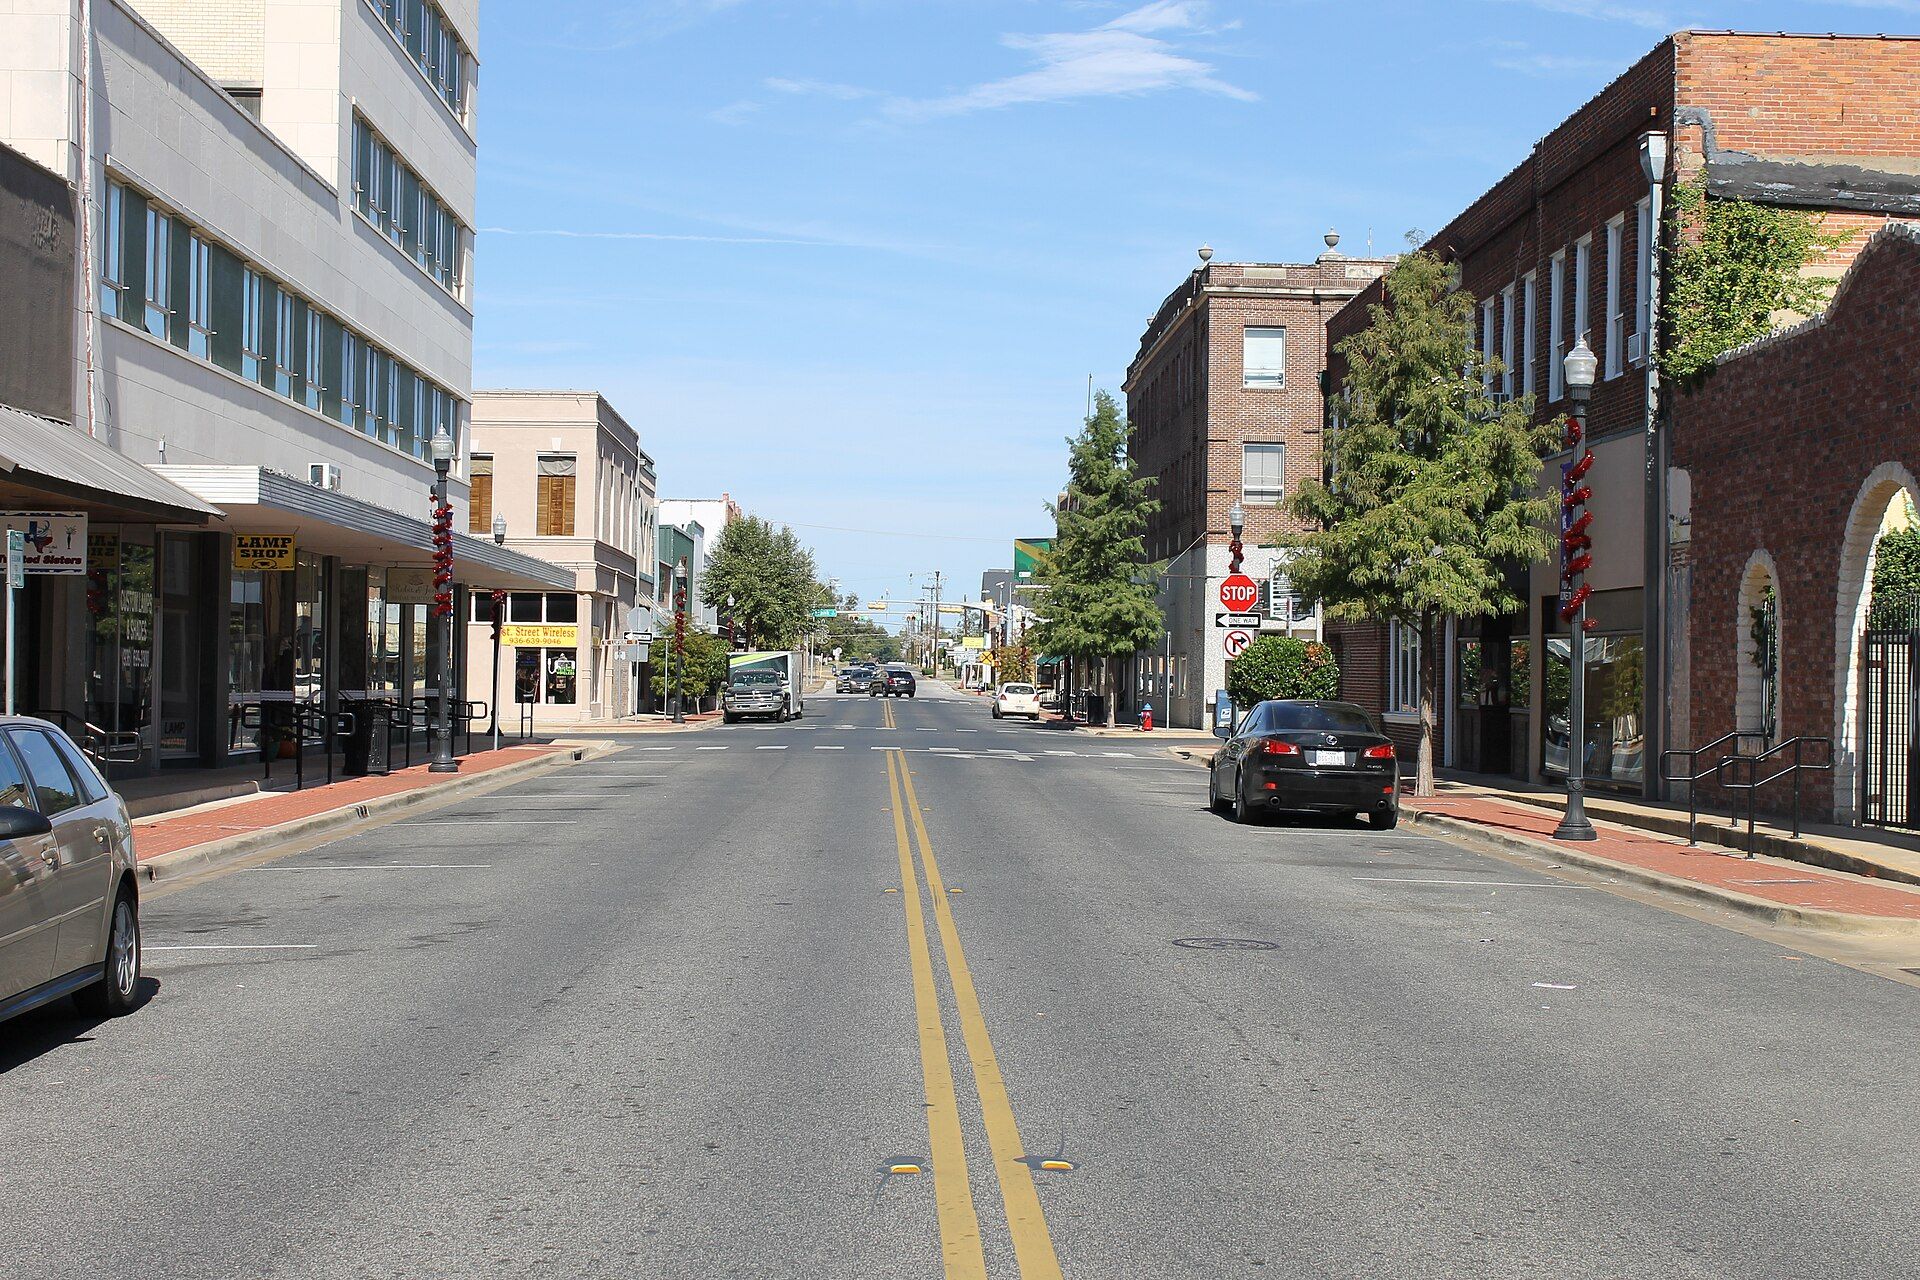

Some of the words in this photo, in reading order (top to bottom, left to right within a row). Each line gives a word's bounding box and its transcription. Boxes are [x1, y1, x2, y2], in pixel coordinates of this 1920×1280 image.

[237, 537, 292, 548] LAMP
[240, 549, 288, 558] SHOP
[43, 555, 82, 564] Sisters
[1222, 586, 1255, 601] STOP
[515, 627, 540, 637] Street
[542, 627, 575, 637] Wireless
[509, 637, 562, 645] 936-639-9046
[165, 721, 186, 735] LAMP
